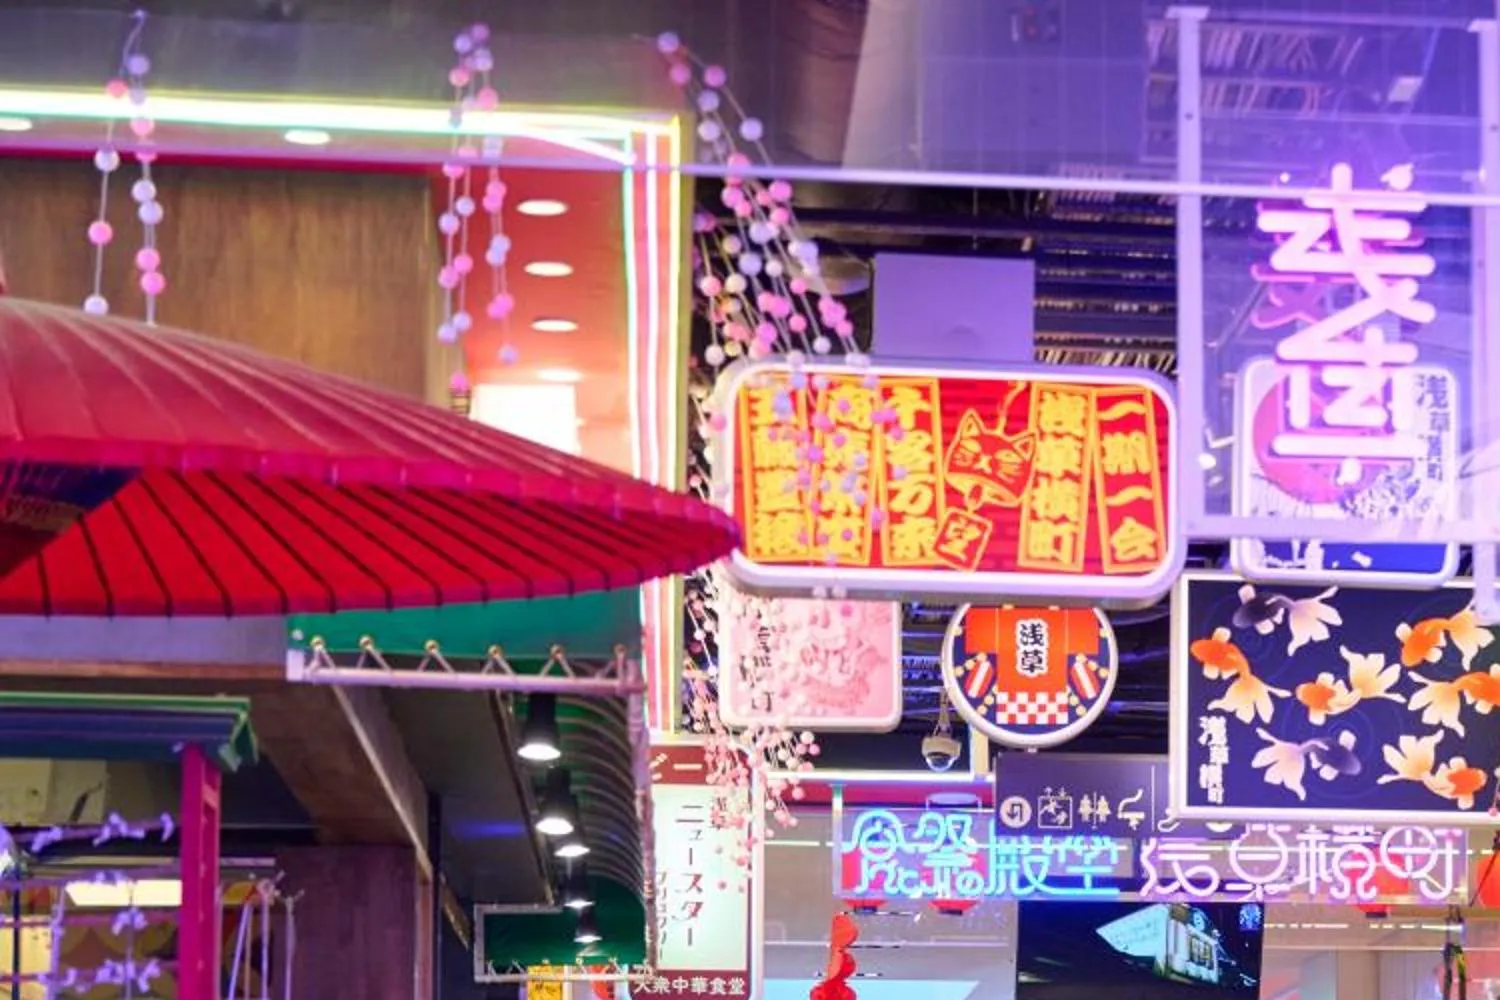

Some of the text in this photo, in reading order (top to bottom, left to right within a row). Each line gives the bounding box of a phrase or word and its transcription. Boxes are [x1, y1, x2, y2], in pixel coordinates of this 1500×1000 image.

[1099, 399, 1158, 561] 一期一会
[1020, 623, 1044, 673] 浅草
[672, 804, 704, 947] ニュースター
[634, 974, 745, 996] 大衆中華食堂
